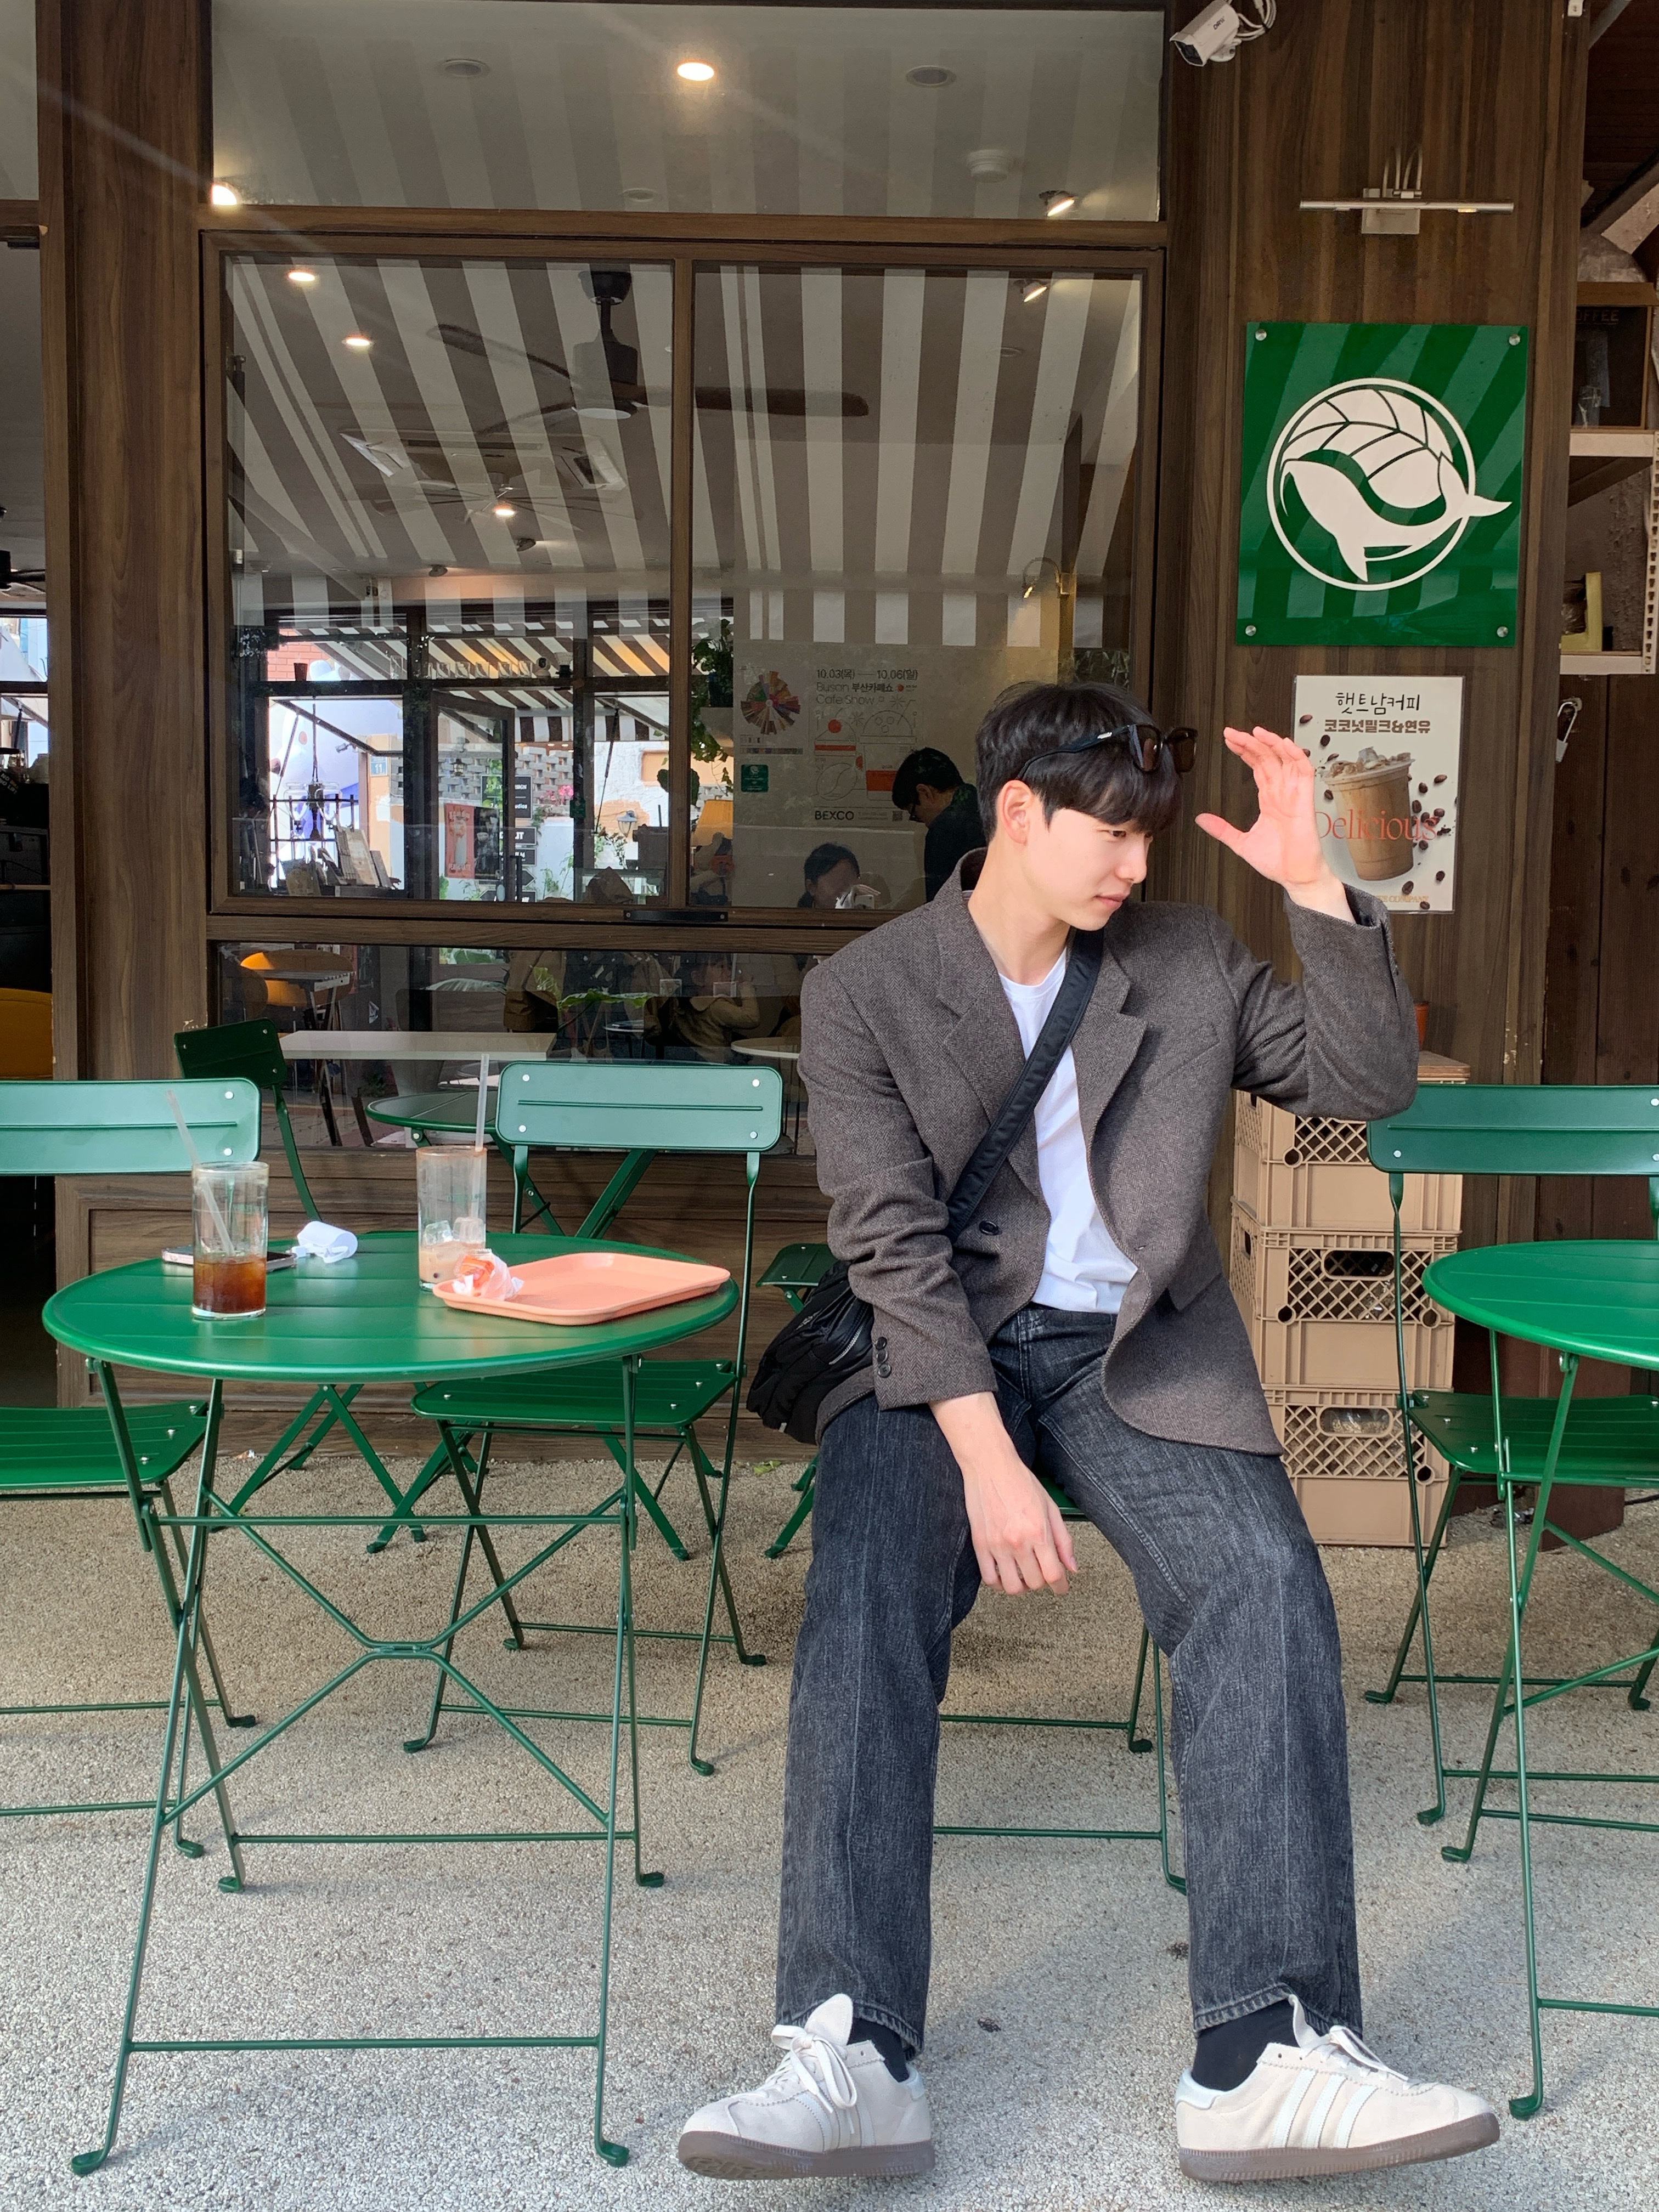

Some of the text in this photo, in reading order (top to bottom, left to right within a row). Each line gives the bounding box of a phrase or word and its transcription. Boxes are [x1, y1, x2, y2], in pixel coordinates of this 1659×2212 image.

[817, 669, 918, 681] 10.03(목) 10.06(일)
[852, 682, 894, 692] 부산카페쇼
[1325, 719, 1431, 733] 코코넛밀크&연유
[815, 811, 854, 821] BEXCO
[1316, 809, 1437, 840] Delicious
